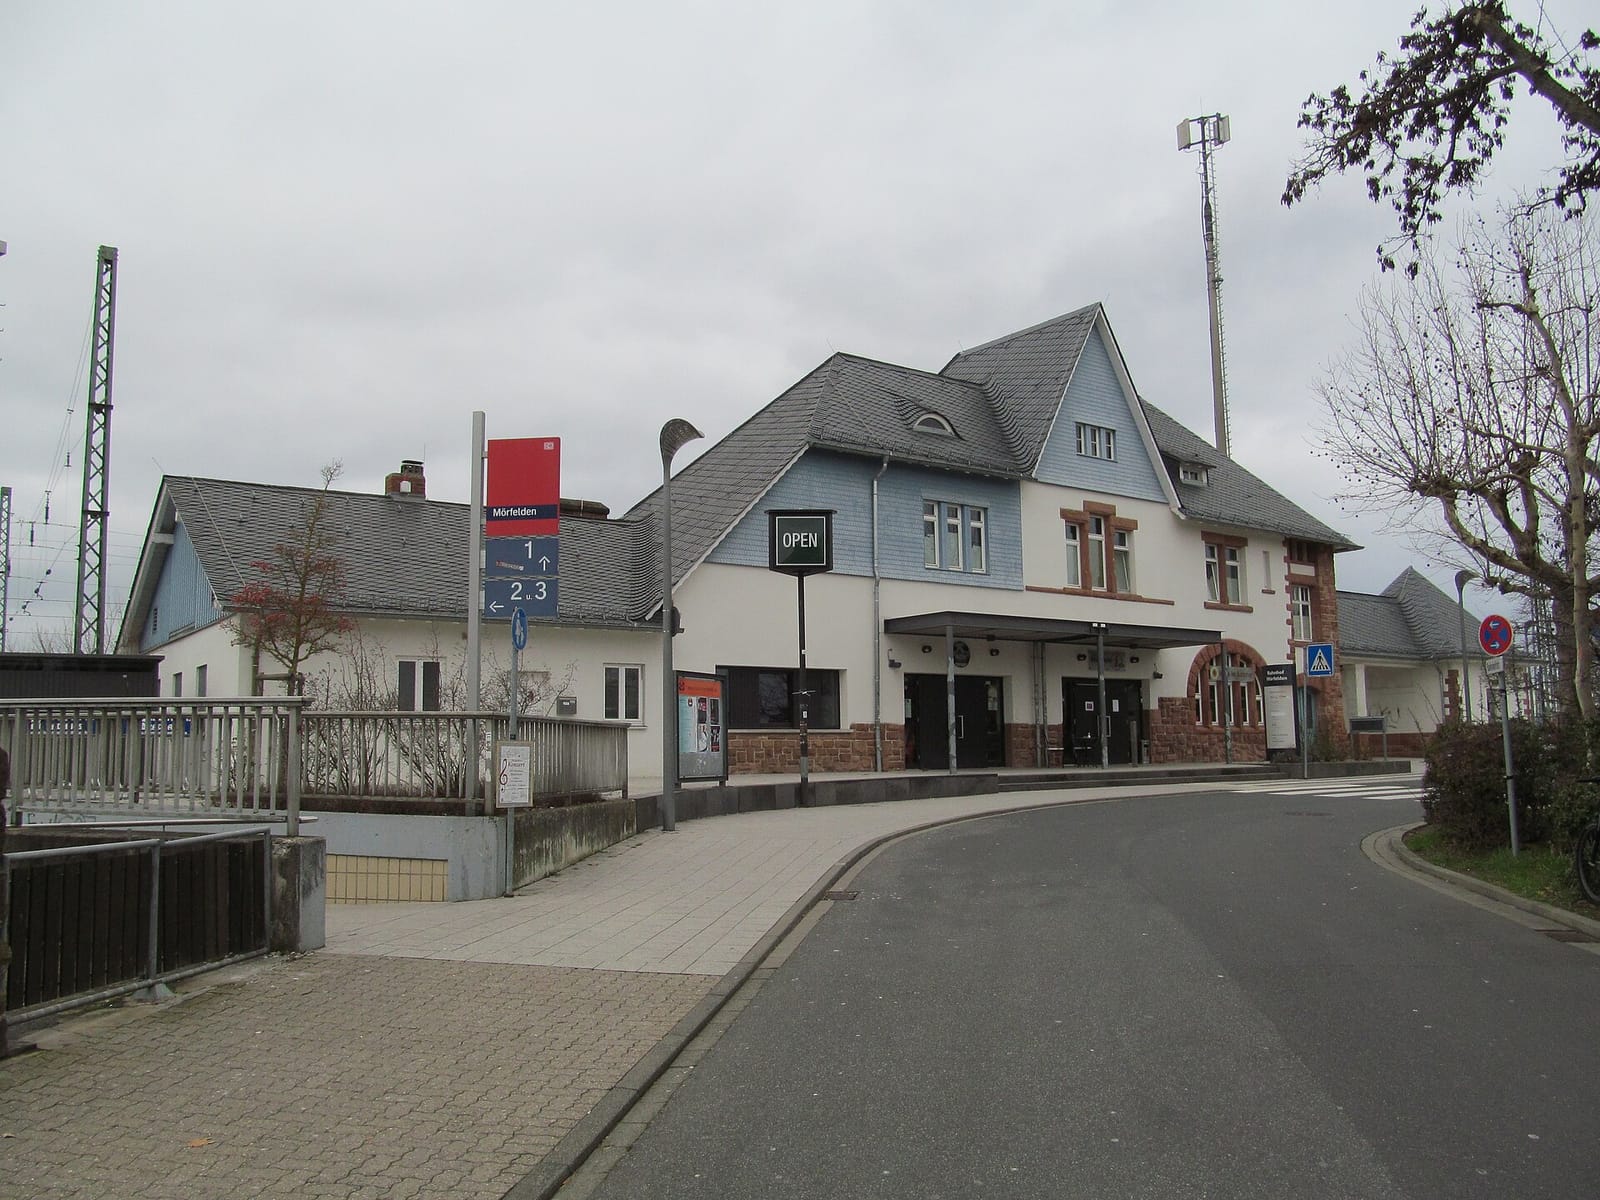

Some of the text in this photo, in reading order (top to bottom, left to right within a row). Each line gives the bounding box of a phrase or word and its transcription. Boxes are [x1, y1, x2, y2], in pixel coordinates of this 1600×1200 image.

[493, 507, 537, 517] Mörfelden
[783, 532, 818, 548] OPEN
[524, 540, 533, 559] 1
[511, 582, 523, 600] 2
[535, 581, 547, 600] 3
